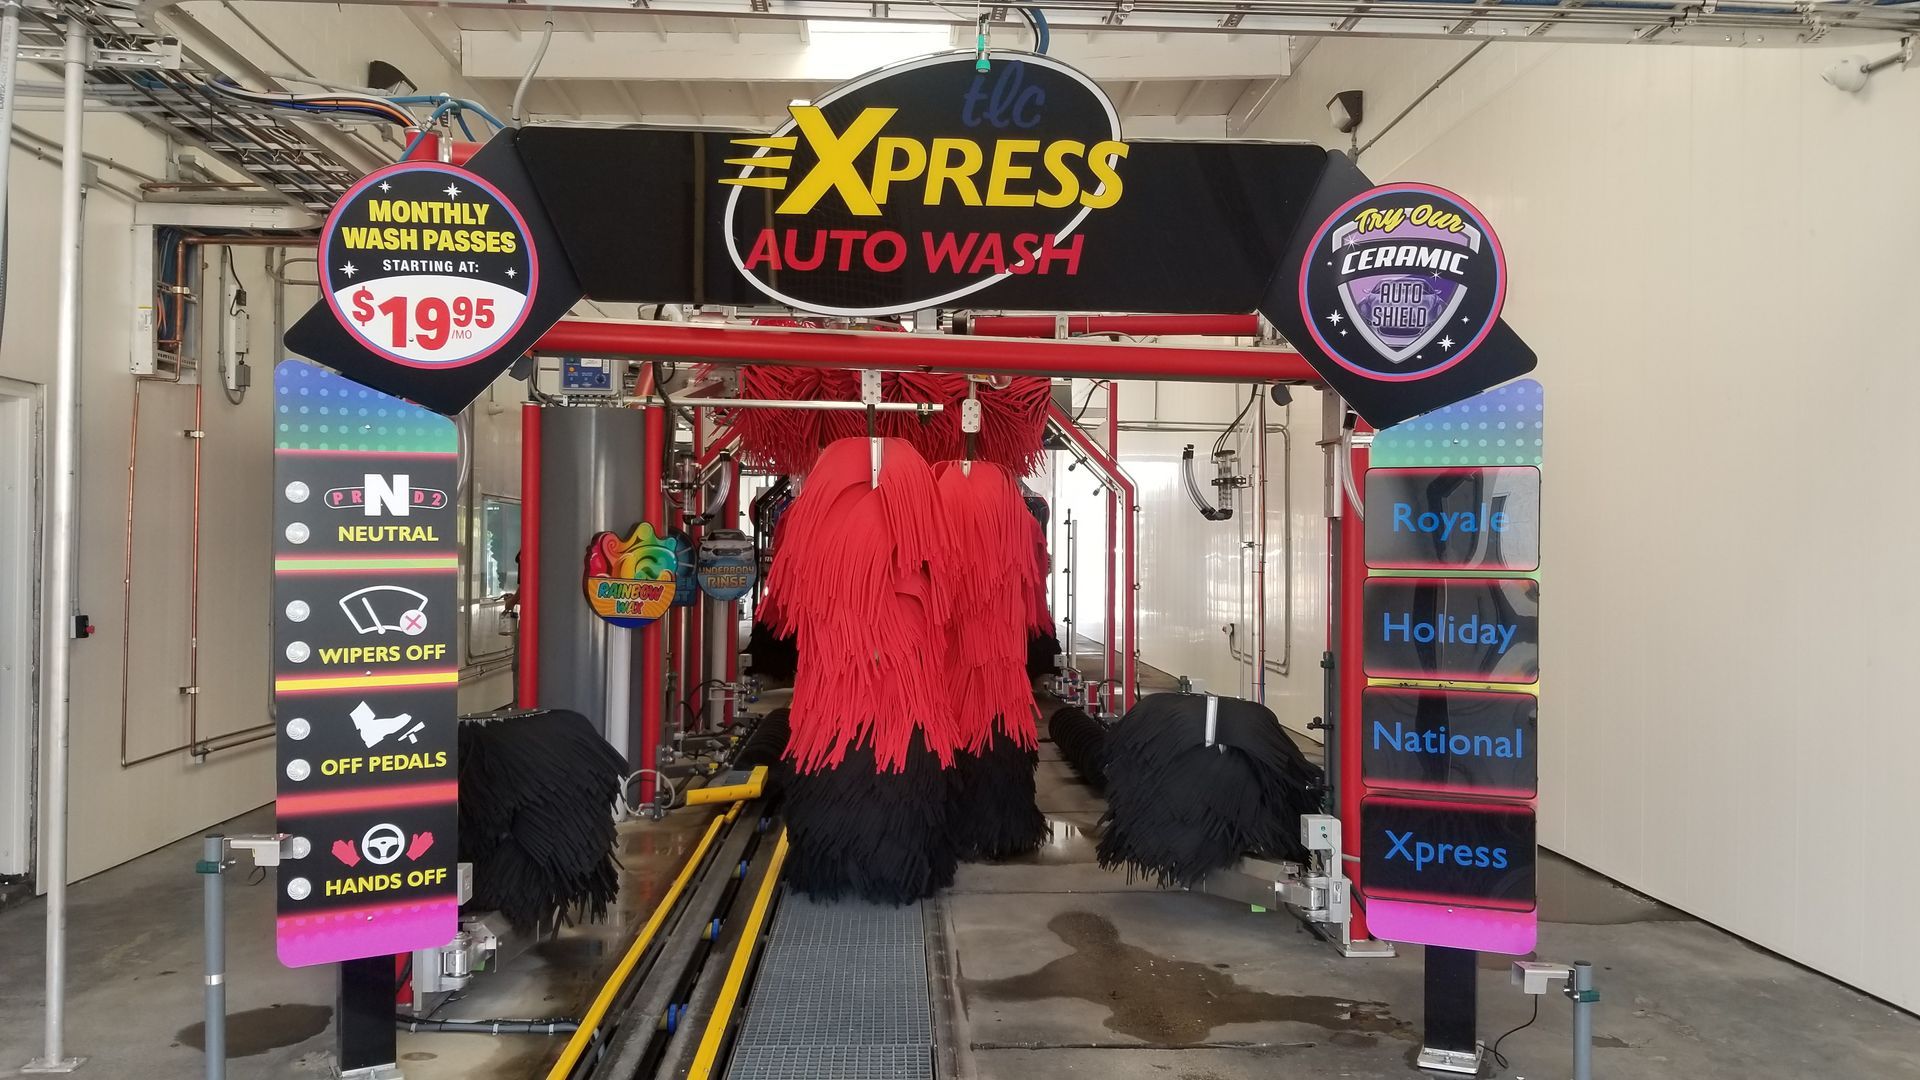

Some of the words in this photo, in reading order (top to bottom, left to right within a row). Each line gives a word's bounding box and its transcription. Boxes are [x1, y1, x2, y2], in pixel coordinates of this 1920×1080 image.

[962, 60, 1047, 129] tlc
[368, 199, 490, 226] MONTHLY
[1355, 207, 1405, 235] Try
[1410, 204, 1465, 234] Our
[342, 227, 418, 251] WASH
[423, 230, 517, 254] PASSES
[743, 229, 907, 273] AUTO
[922, 231, 1085, 276] WASH
[383, 259, 453, 273] STARTING
[458, 261, 479, 273] AT:
[1341, 245, 1469, 275] CERAMIC
[1379, 283, 1422, 304] AUTO
[1372, 307, 1427, 328] SHIELD
[338, 526, 439, 542] NEUTRAL
[1393, 502, 1510, 541] Royale
[700, 566, 753, 575] UNDERBODY
[707, 576, 747, 589] RINSE
[597, 581, 664, 602] RAINBOW
[616, 600, 644, 615] WAX
[1383, 612, 1517, 654] Holiday
[318, 645, 400, 665] WIPERS
[405, 644, 446, 661] OFF
[1373, 720, 1522, 759] National
[321, 756, 362, 776] OFF
[368, 751, 447, 773] PEDALS
[1384, 830, 1508, 871] Xpress
[325, 873, 401, 897] HANDS
[407, 868, 447, 887] OFF
